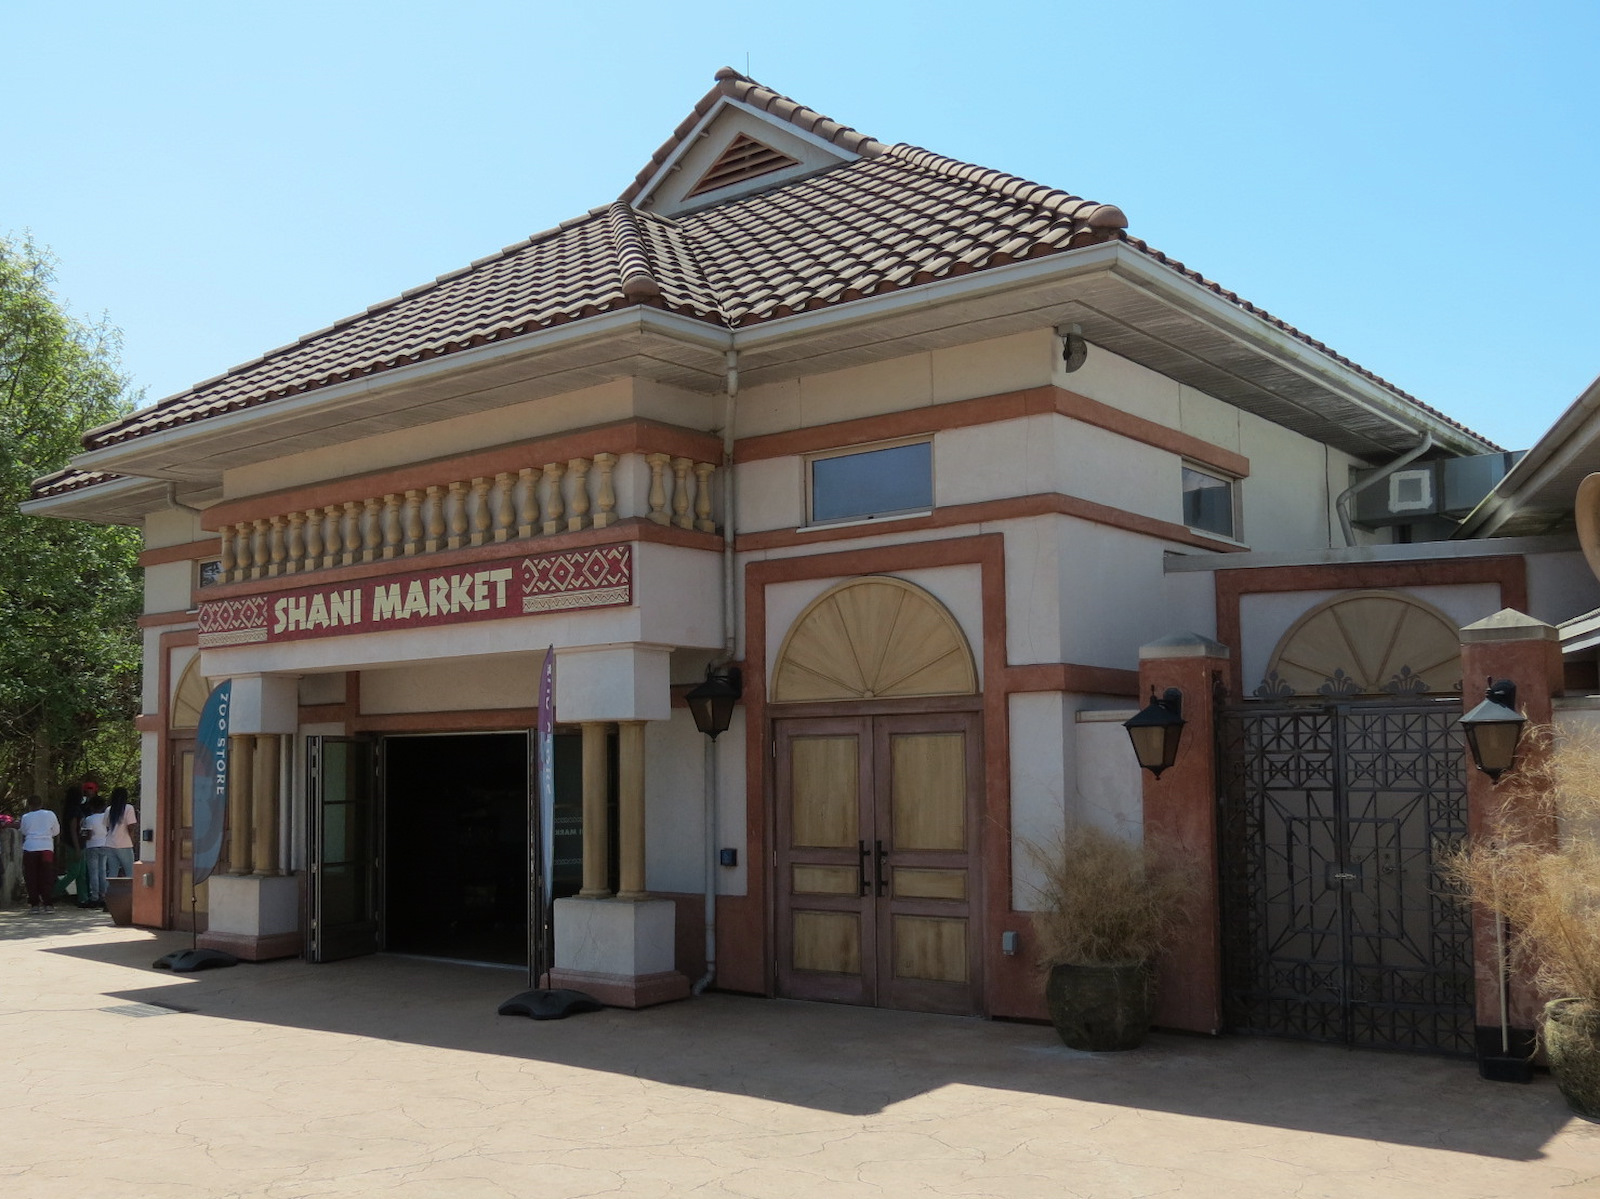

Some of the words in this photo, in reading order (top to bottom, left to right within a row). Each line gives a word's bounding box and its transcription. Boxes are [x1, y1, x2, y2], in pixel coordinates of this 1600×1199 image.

[274, 588, 362, 634] SHANI
[372, 568, 513, 622] MARKET
[218, 693, 229, 731] ZOO
[216, 738, 226, 795] STORE
